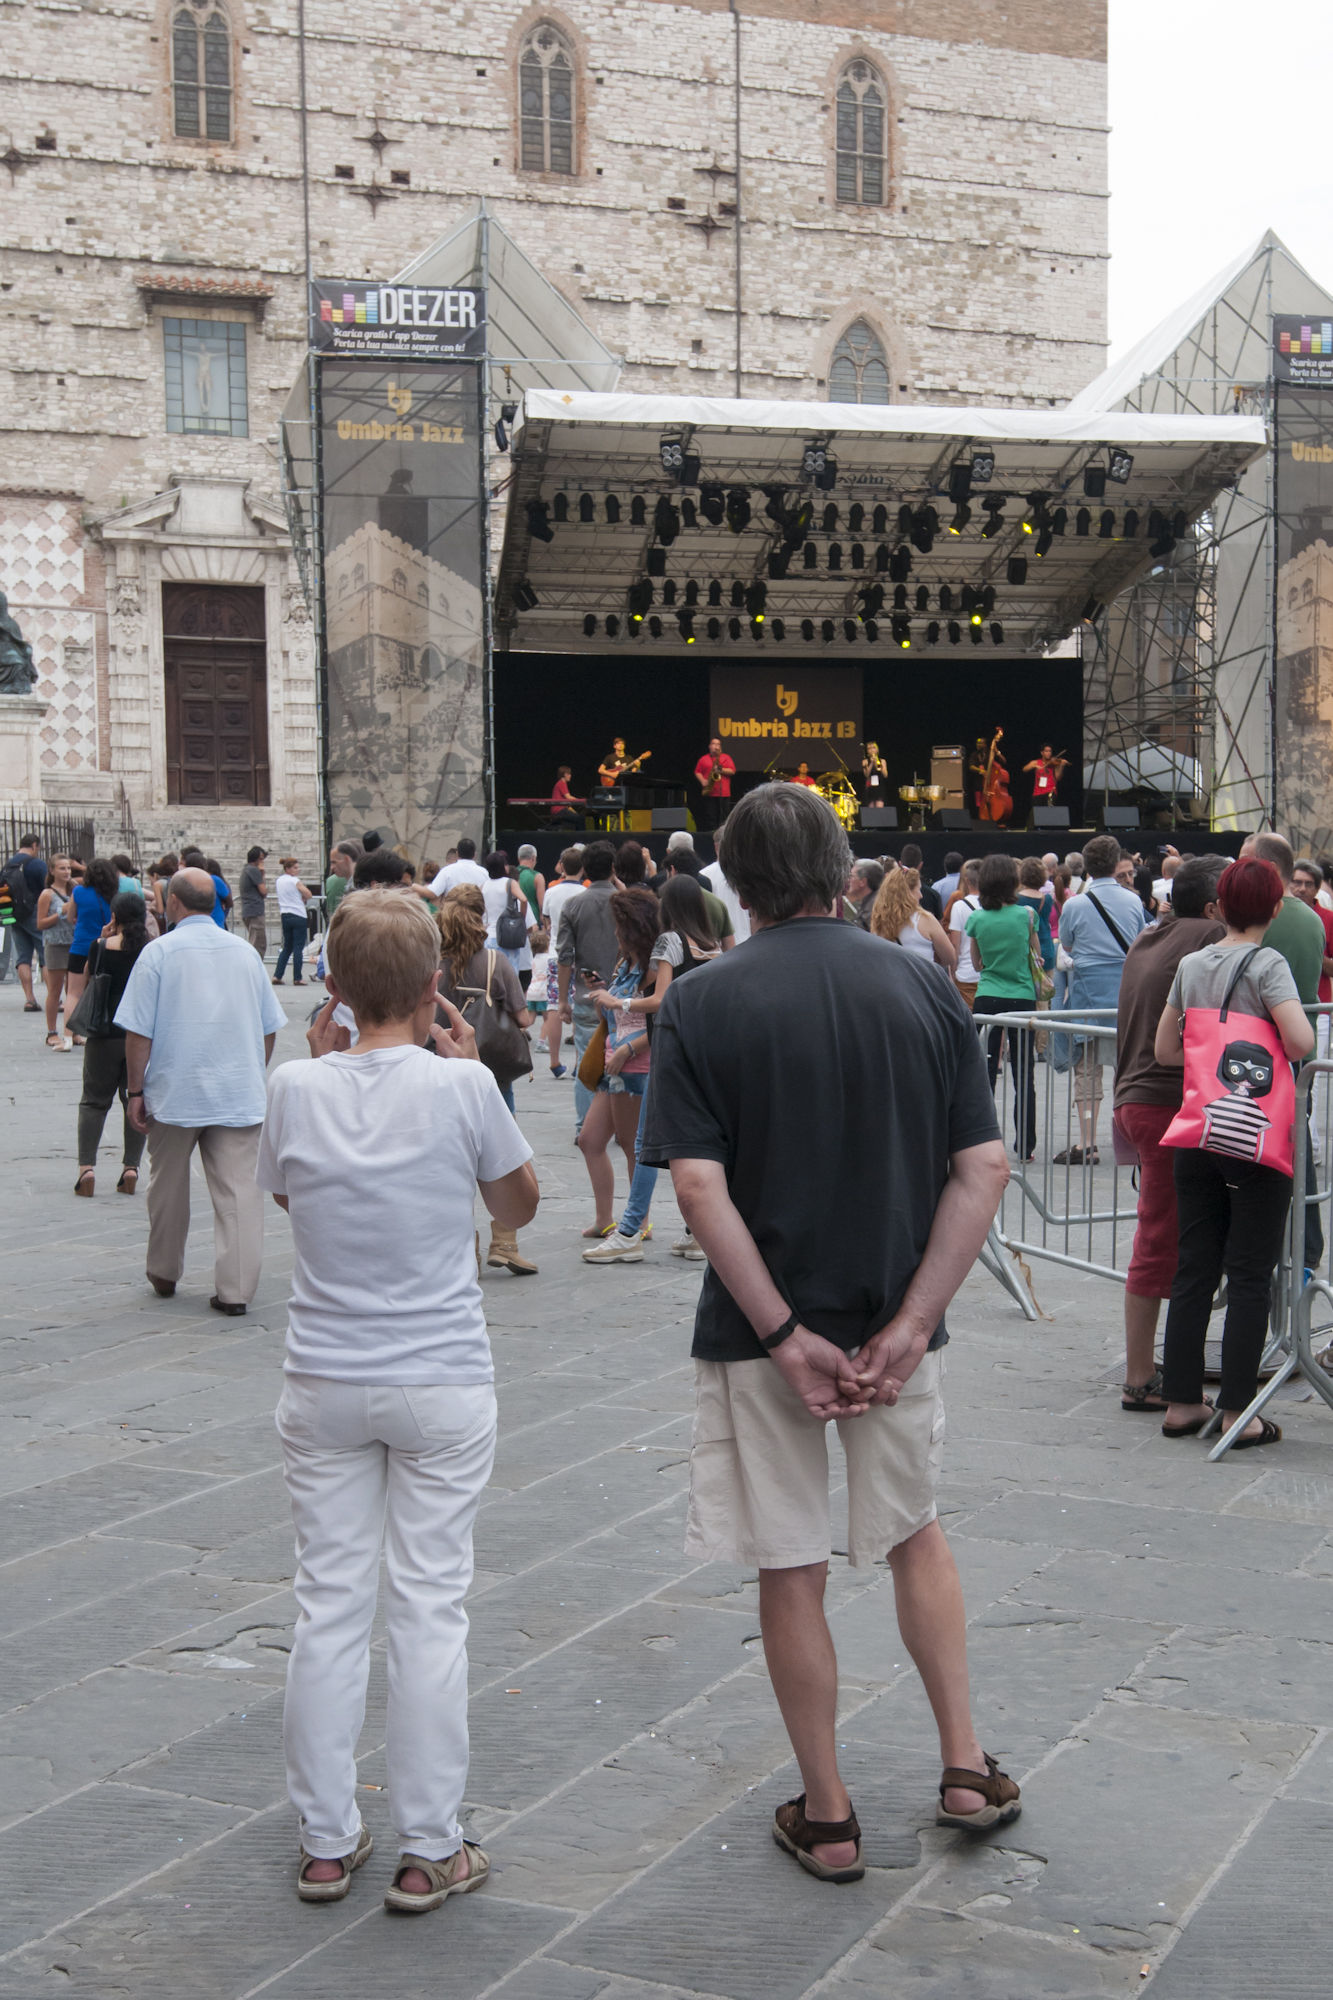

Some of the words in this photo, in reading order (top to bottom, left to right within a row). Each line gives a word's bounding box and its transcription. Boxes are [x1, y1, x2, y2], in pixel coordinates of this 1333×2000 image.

[380, 288, 477, 328] DEEZER
[333, 327, 363, 338] Scarica
[364, 330, 388, 340] gratis
[411, 331, 438, 341] Deezer
[333, 338, 355, 348] Porta
[357, 339, 365, 348] la
[366, 339, 380, 349] tua
[382, 341, 410, 351] musica
[411, 343, 439, 353] sempre
[440, 344, 455, 352] con
[455, 343, 466, 352] te!
[1290, 357, 1318, 368] Scarica
[1290, 367, 1310, 377] Porta
[1310, 369, 1319, 377] la
[1319, 369, 1332, 378] tua
[337, 420, 415, 441] Umbria
[421, 422, 465, 444] Jazz
[718, 718, 789, 738] Umbria
[792, 718, 832, 738] Jazz
[836, 720, 856, 738] 13
